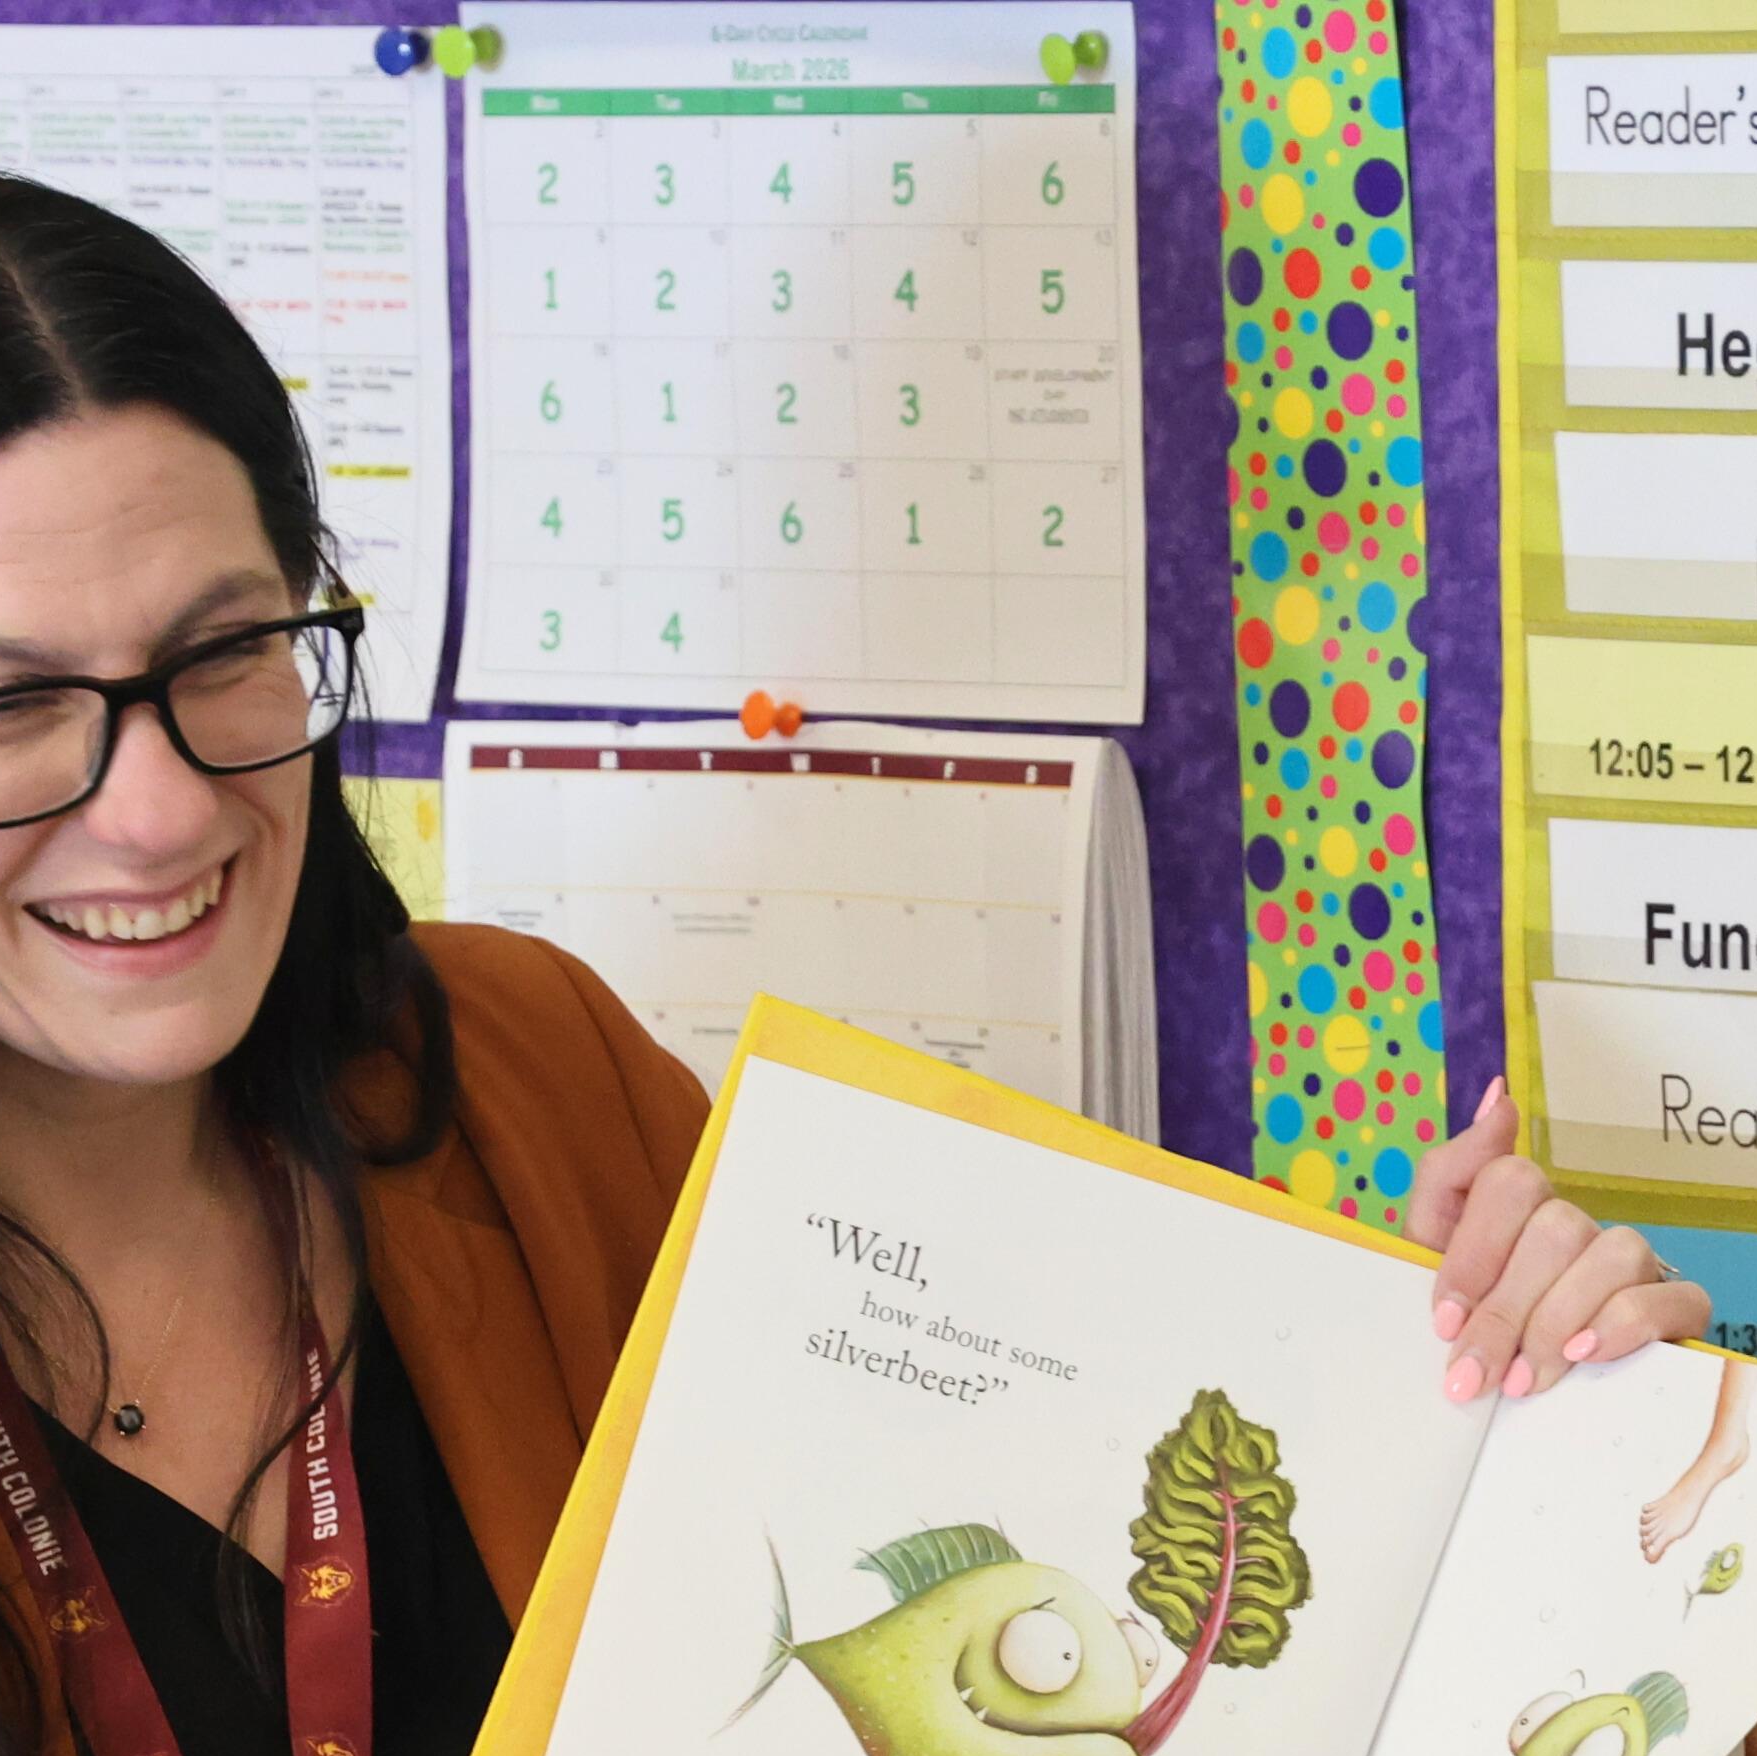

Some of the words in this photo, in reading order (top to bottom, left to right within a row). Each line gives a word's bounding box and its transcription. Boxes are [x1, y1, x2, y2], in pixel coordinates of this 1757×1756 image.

[537, 162, 559, 205] 2
[655, 162, 676, 206] 3
[769, 162, 794, 205] 4
[892, 161, 916, 206] 5
[1041, 160, 1066, 206] 6
[543, 269, 559, 311] 1
[655, 268, 676, 311] 2
[771, 268, 793, 312] 3
[894, 269, 919, 313] 4
[1041, 269, 1066, 314] 5
[540, 379, 563, 424] 6
[660, 381, 678, 423] 1
[776, 382, 798, 424] 2
[898, 383, 921, 427] 3
[540, 496, 563, 538] 4
[661, 497, 685, 542] 5
[781, 501, 803, 544] 6
[904, 501, 923, 545] 1
[1042, 504, 1065, 547] 2
[538, 609, 562, 652] 3
[660, 611, 685, 654] 4
[1587, 739, 1675, 780] 12:05
[805, 1211, 929, 1293] “Well,
[804, 1328, 1010, 1406] silverbeet?”
[859, 1290, 920, 1330] how
[925, 1315, 1003, 1358] about
[1008, 1346, 1080, 1382] some
[306, 1347, 328, 1454] COLNIE
[1, 1470, 67, 1577] COLONIE
[306, 1456, 339, 1541] SOUTH
